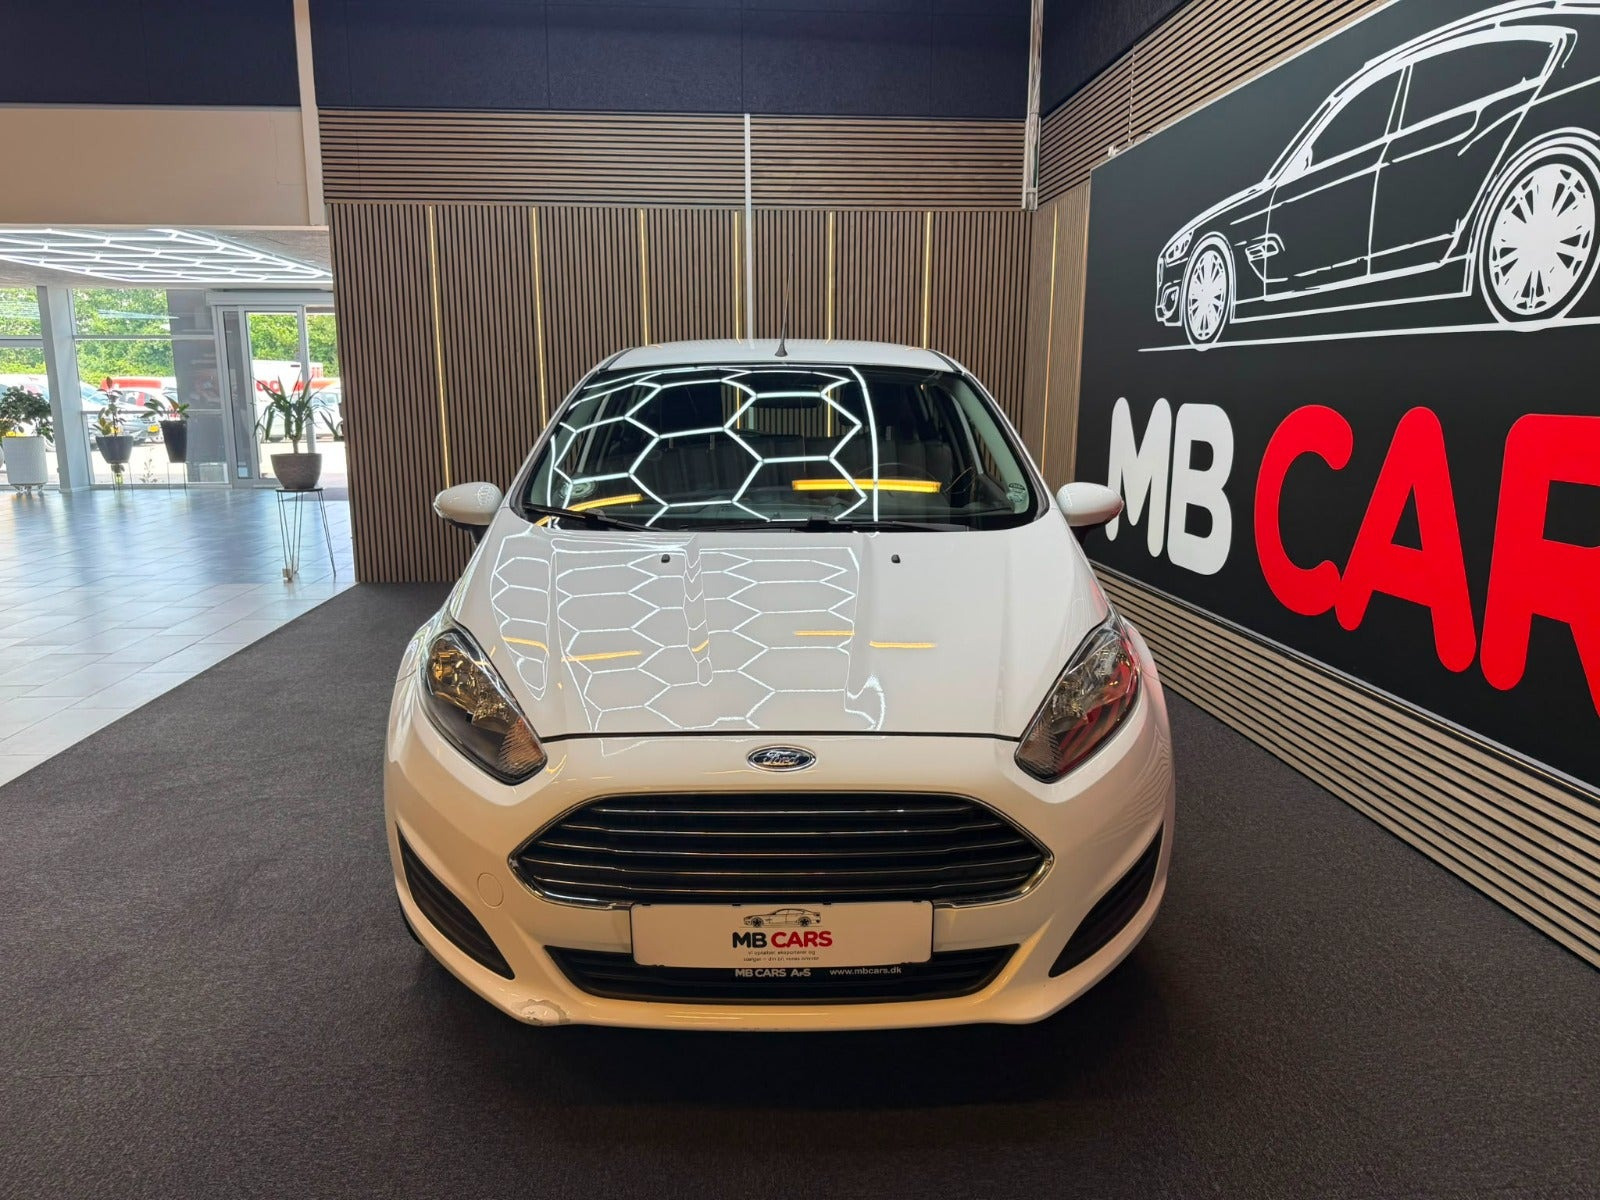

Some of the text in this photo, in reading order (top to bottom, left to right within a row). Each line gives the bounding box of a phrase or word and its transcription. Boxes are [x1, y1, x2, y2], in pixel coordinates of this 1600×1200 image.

[1106, 397, 1234, 575] MB
[762, 749, 800, 765] Ford
[732, 930, 833, 948] MB CARS
[735, 968, 753, 977] MB
[755, 968, 787, 977] CARS
[829, 966, 902, 976] www.mbcars.dk
